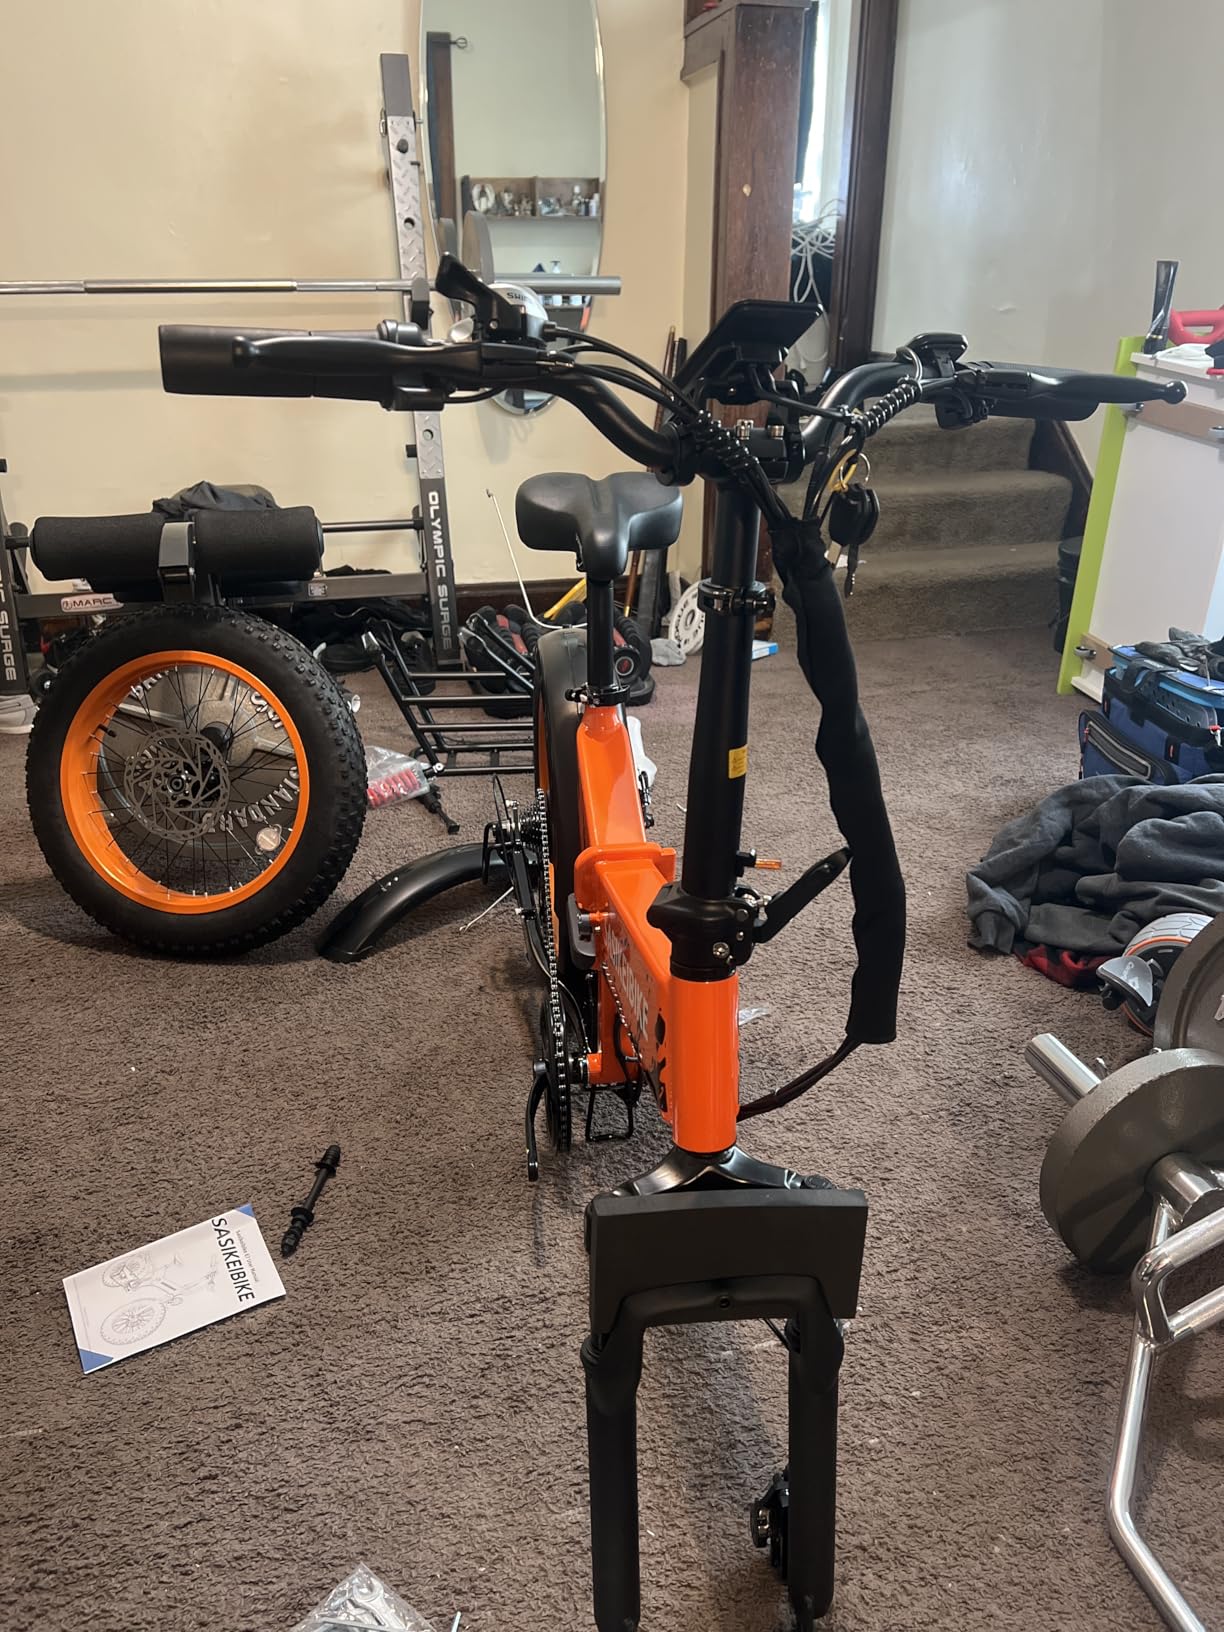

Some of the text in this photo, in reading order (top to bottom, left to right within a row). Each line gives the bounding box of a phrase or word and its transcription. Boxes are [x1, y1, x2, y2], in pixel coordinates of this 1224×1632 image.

[73, 597, 113, 607] MARC
[428, 491, 452, 649] OLYMPIC SURGE
[0, 610, 17, 680] SURGE
[212, 1218, 256, 1302] SASIKEIBIKE
